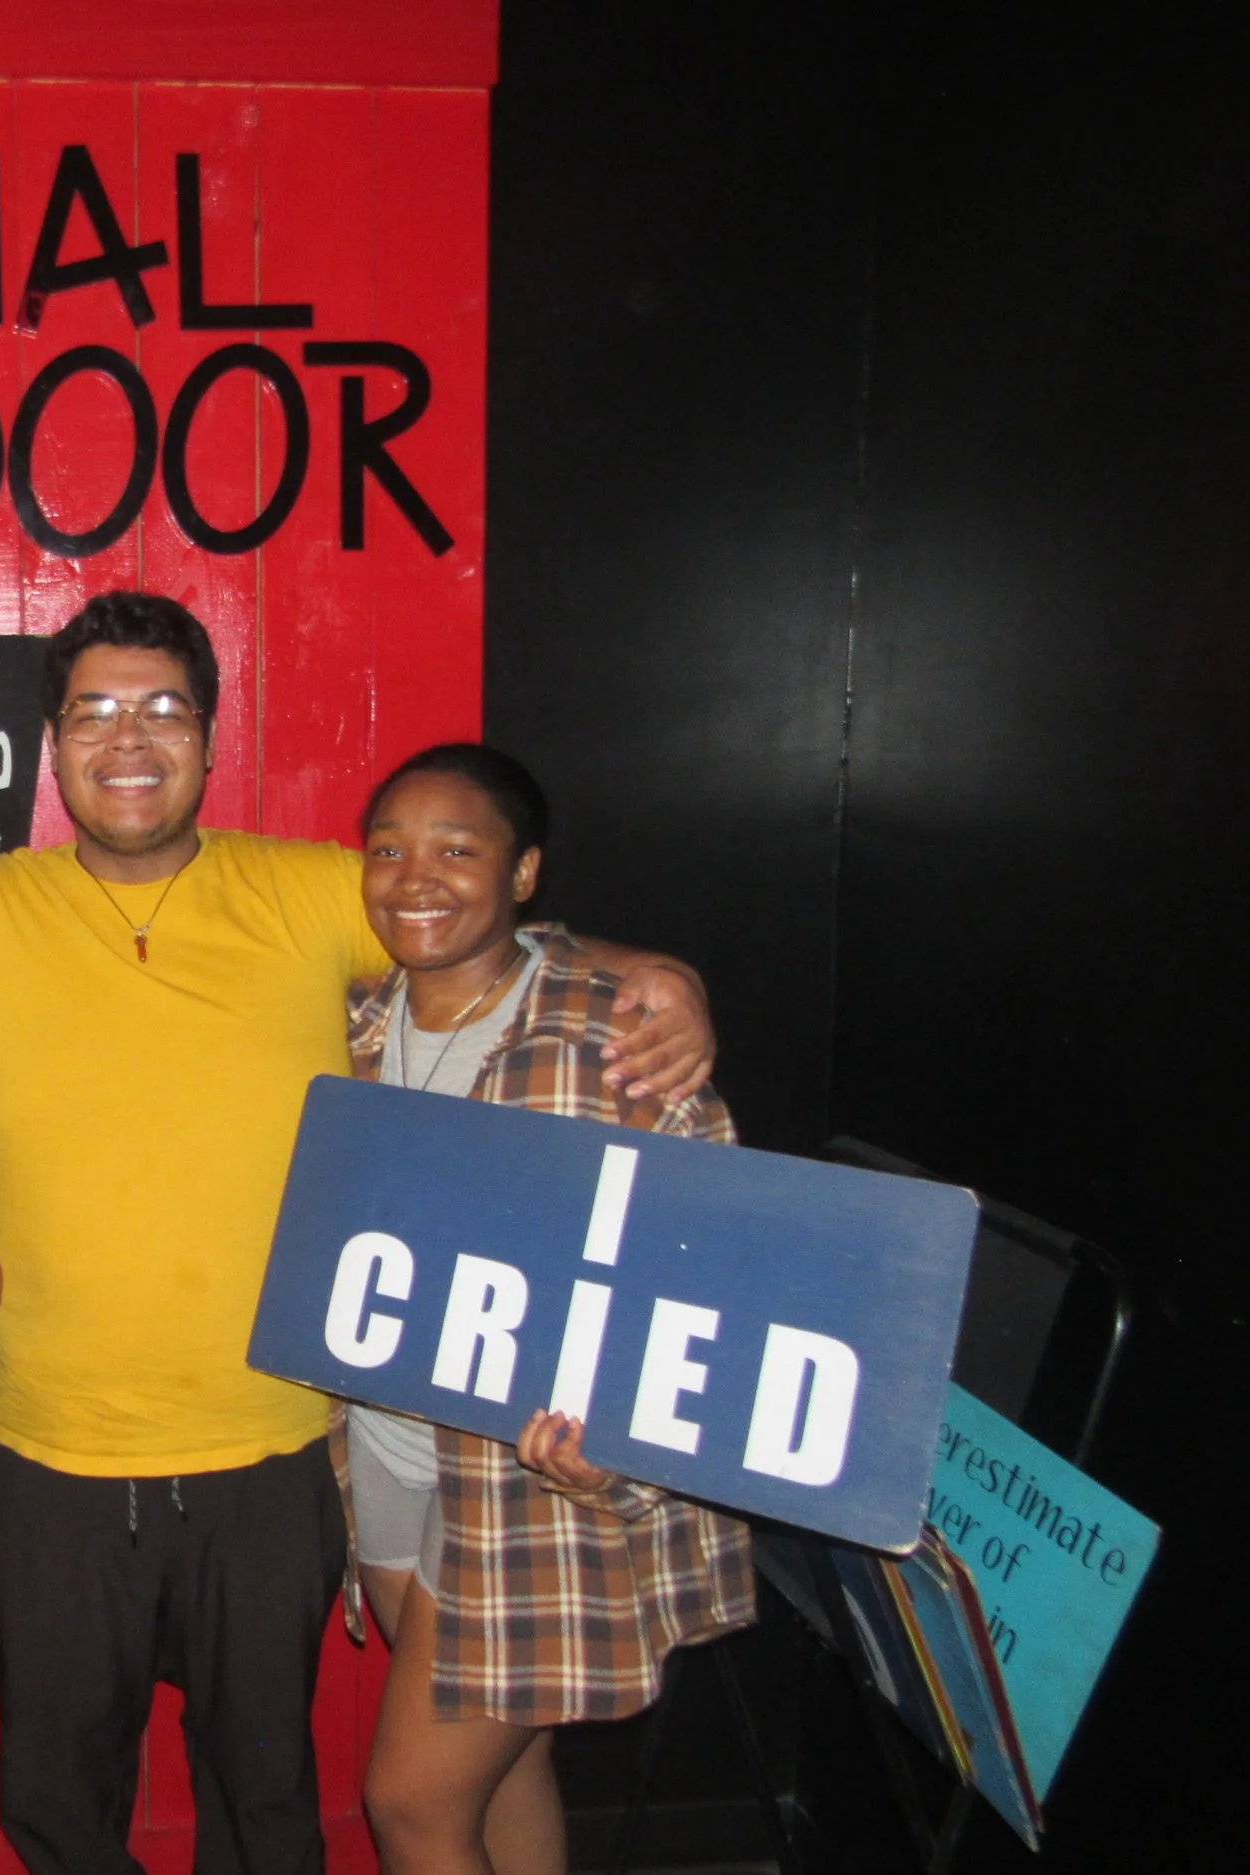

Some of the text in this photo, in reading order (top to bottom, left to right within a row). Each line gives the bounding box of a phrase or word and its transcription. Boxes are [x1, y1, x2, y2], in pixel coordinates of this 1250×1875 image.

[582, 1144, 640, 1267] I
[324, 1231, 861, 1487] CRIED
[981, 1535, 1030, 1584] of
